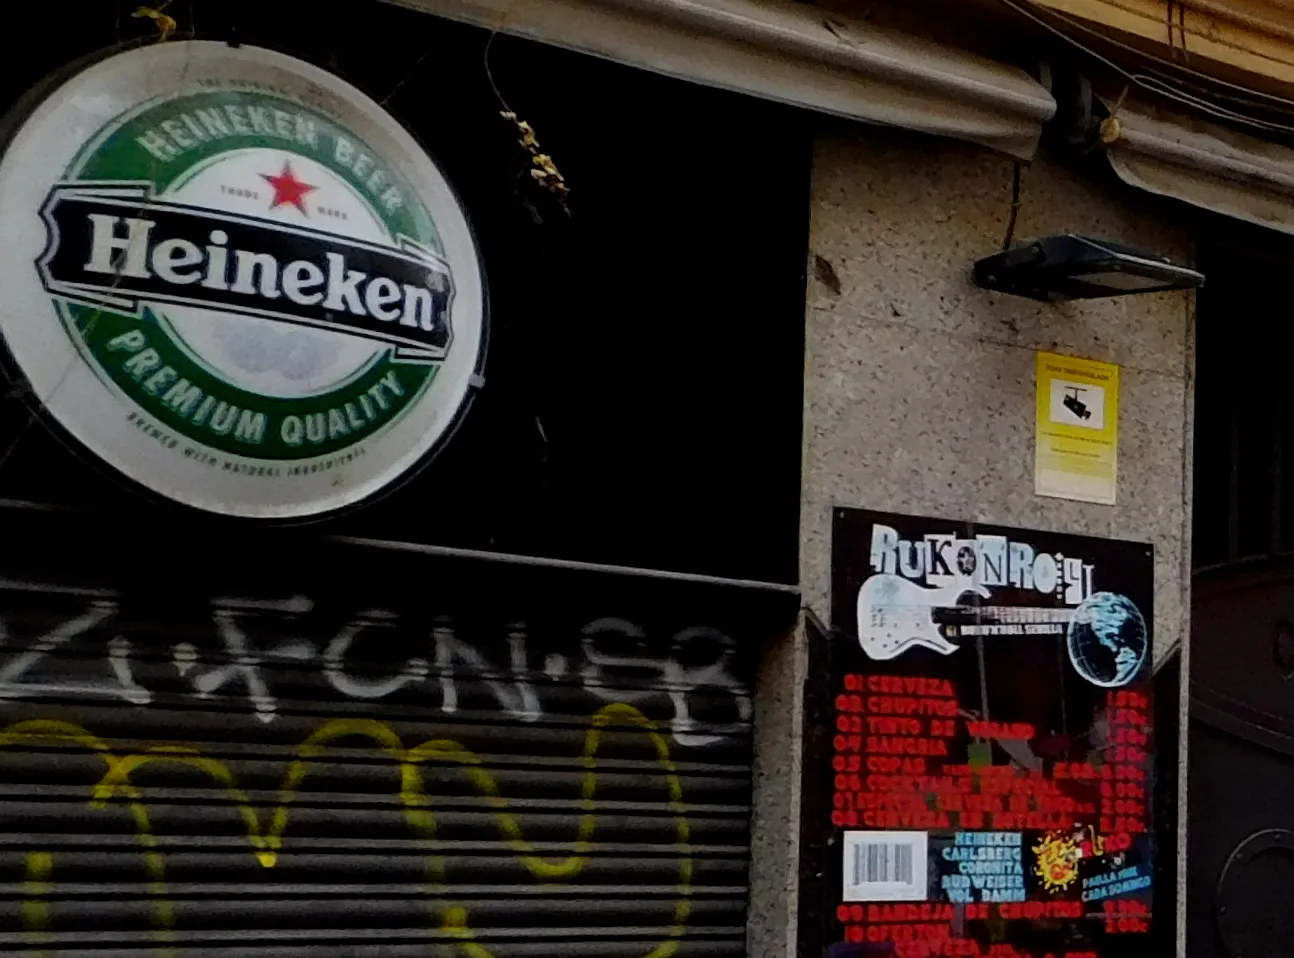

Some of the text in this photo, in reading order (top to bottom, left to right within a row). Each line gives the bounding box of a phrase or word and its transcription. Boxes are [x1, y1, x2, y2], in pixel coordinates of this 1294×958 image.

[135, 105, 403, 215] HEINEKEN BEER
[84, 212, 434, 332] Heineken
[107, 329, 405, 446] PREMIUM QUALITY
[867, 675, 955, 697] CERVEZA
[942, 846, 1023, 861] CARLSBERG
[958, 861, 1024, 876] CORONITA
[867, 903, 954, 922] BANDEJA
